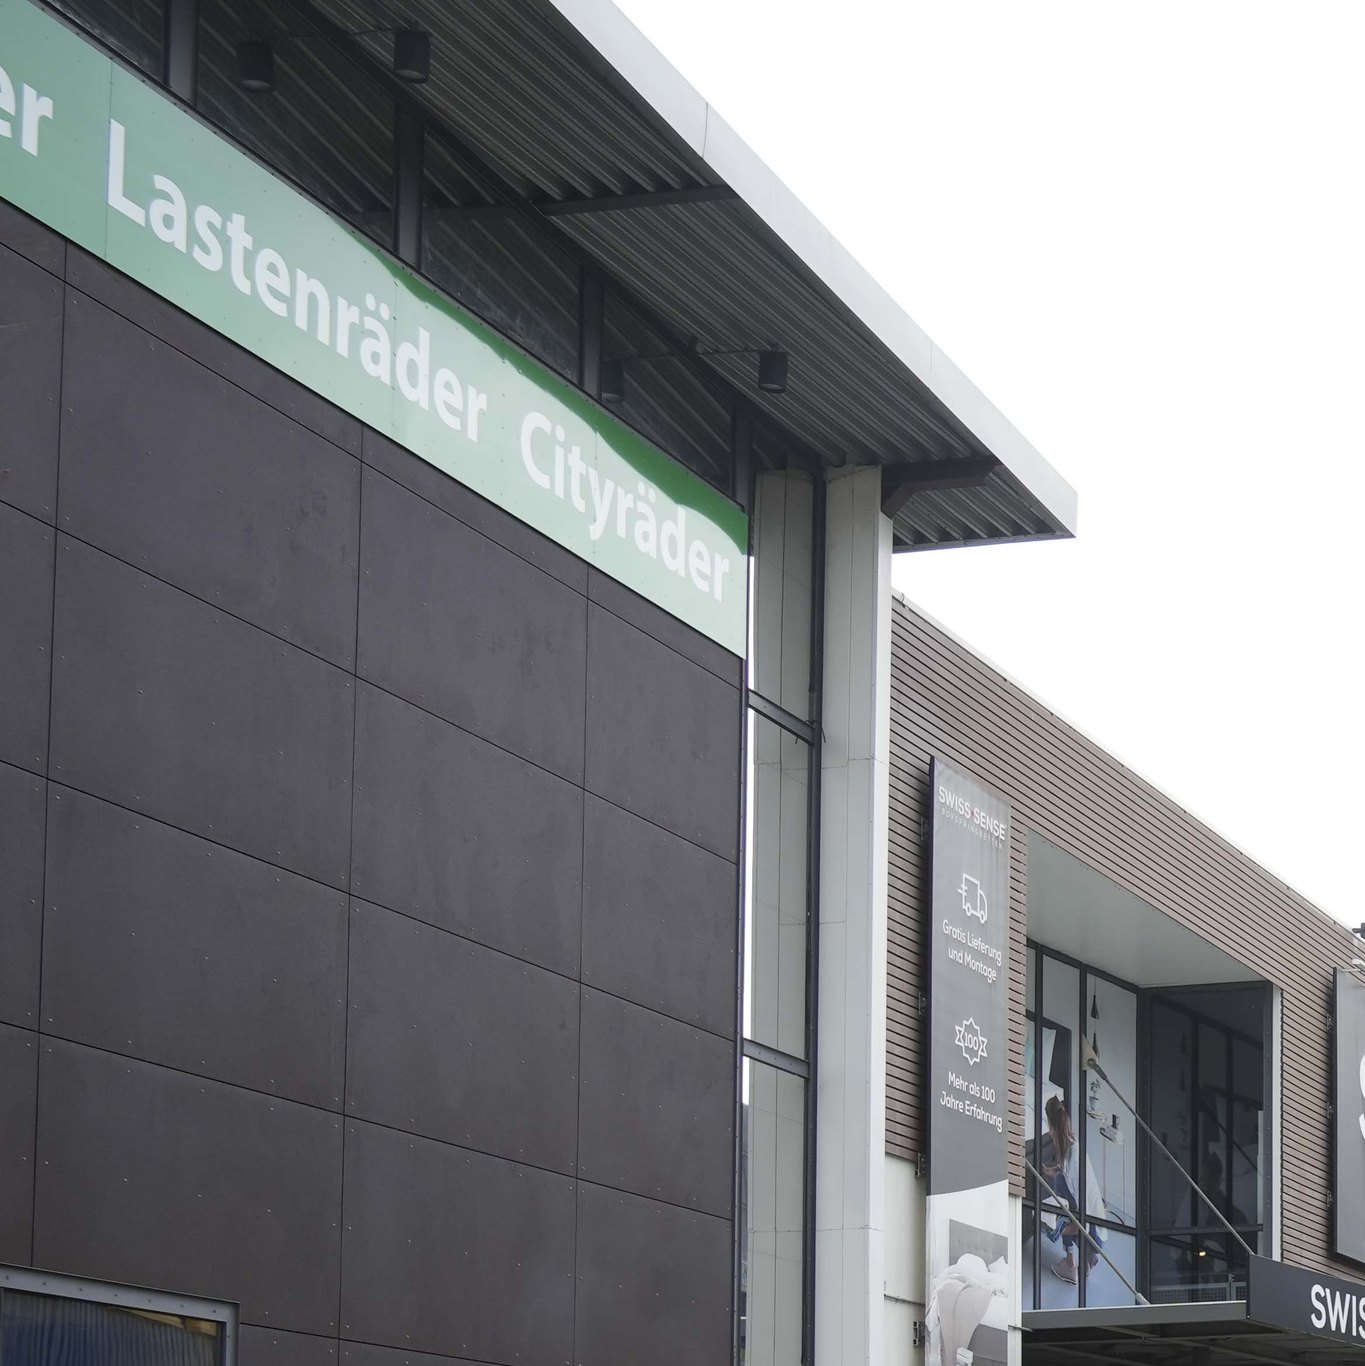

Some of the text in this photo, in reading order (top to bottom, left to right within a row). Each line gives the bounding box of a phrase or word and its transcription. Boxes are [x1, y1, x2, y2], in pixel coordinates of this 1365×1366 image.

[107, 119, 487, 443] Lastenräder
[520, 411, 729, 602] Cityräder
[939, 786, 971, 819] SWISS
[943, 919, 1002, 966] Gratis Lieferung
[948, 947, 997, 983] und Montage
[964, 1032, 979, 1051] 100
[948, 1071, 996, 1103] Mehr als 100
[940, 1091, 1003, 1132] Jahre Erfahrung
